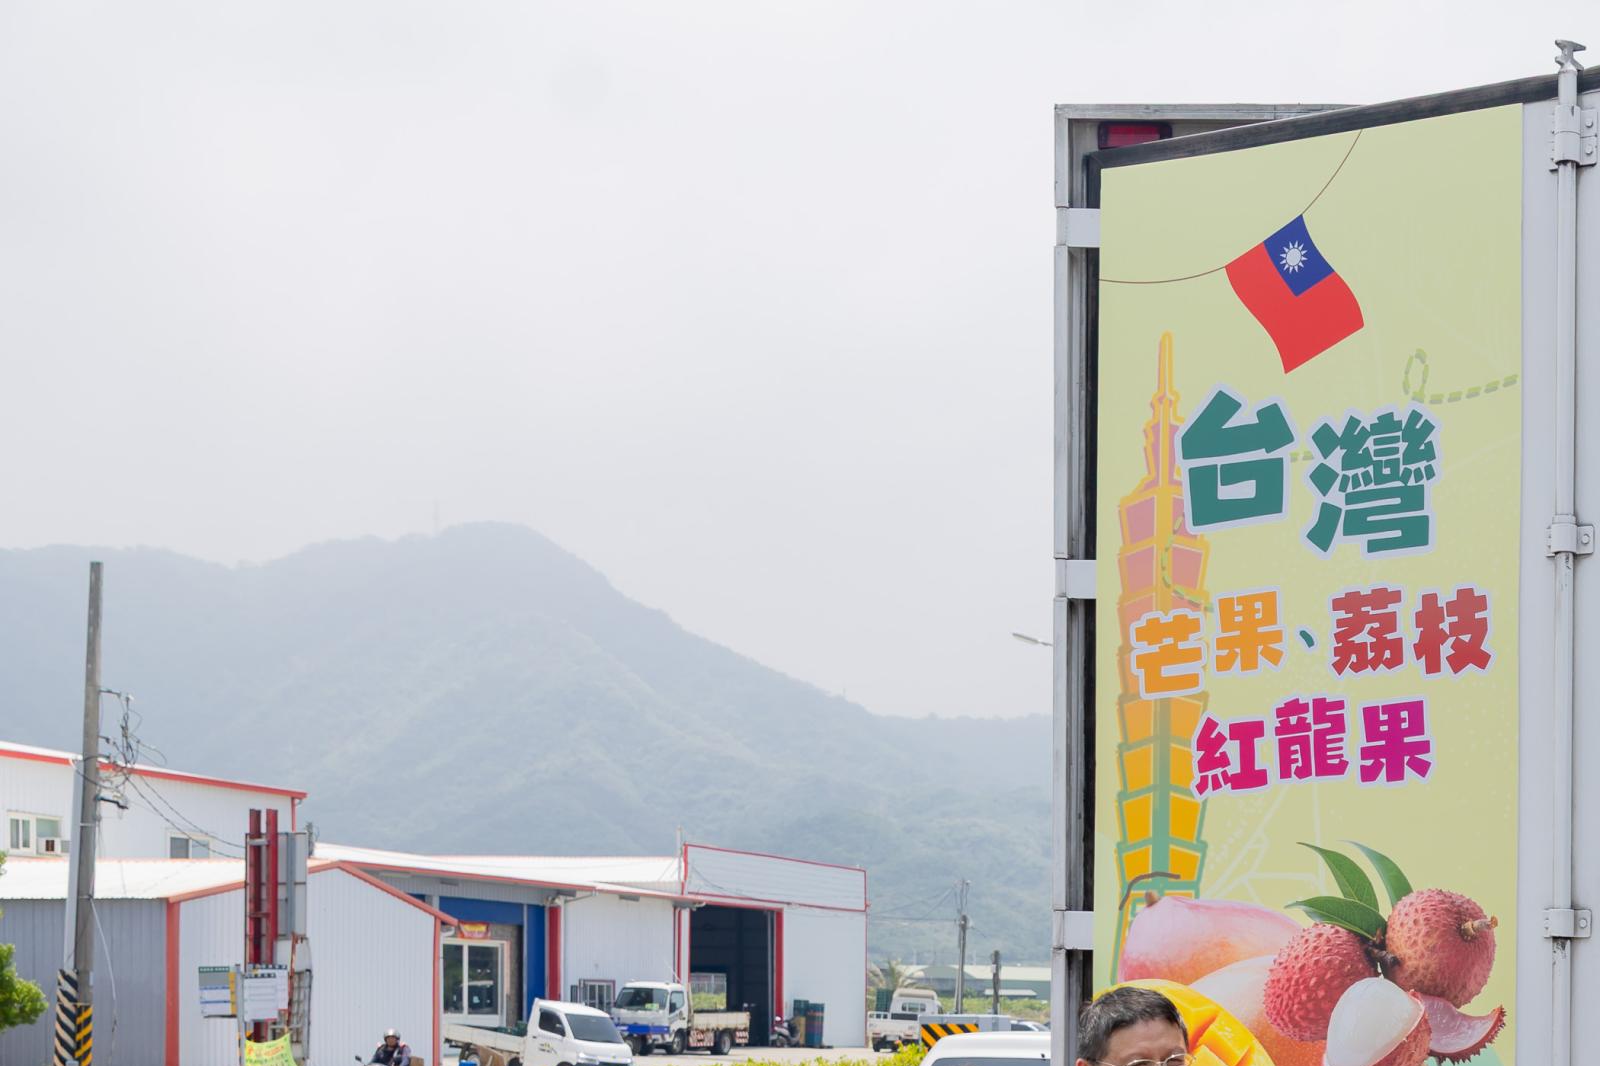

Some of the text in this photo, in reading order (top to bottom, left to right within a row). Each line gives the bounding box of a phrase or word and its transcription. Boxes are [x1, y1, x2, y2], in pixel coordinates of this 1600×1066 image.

[1181, 390, 1438, 554] 台灣
[1194, 697, 1433, 796] 紅龍果
